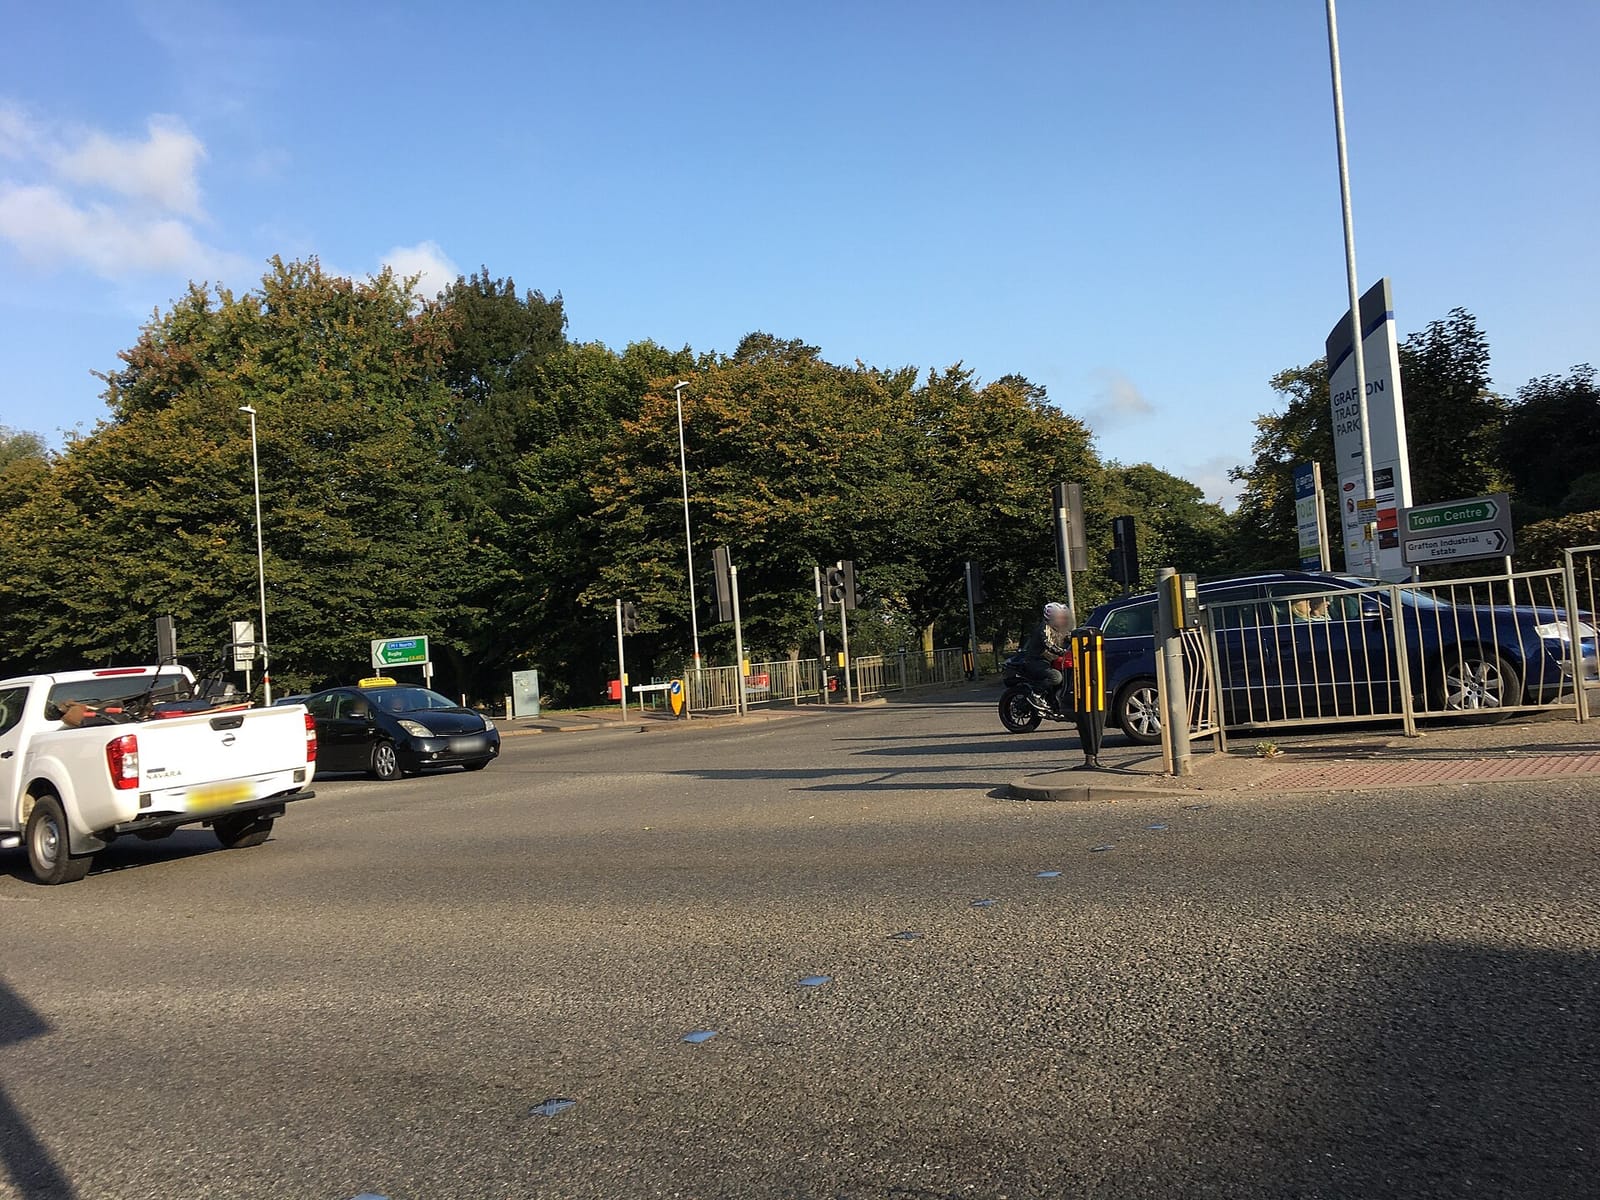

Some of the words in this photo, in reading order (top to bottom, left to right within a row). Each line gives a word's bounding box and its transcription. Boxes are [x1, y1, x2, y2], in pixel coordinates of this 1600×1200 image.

[1334, 379, 1384, 406] GRAFON
[1335, 404, 1359, 421] TRAD
[1337, 418, 1360, 437] PARK
[1412, 515, 1440, 526] Town
[1443, 509, 1482, 521] Centre
[1408, 541, 1438, 551] Grafton
[1440, 535, 1479, 547] Industrial
[1431, 548, 1457, 556] Estate
[146, 770, 181, 779] NAVARA
